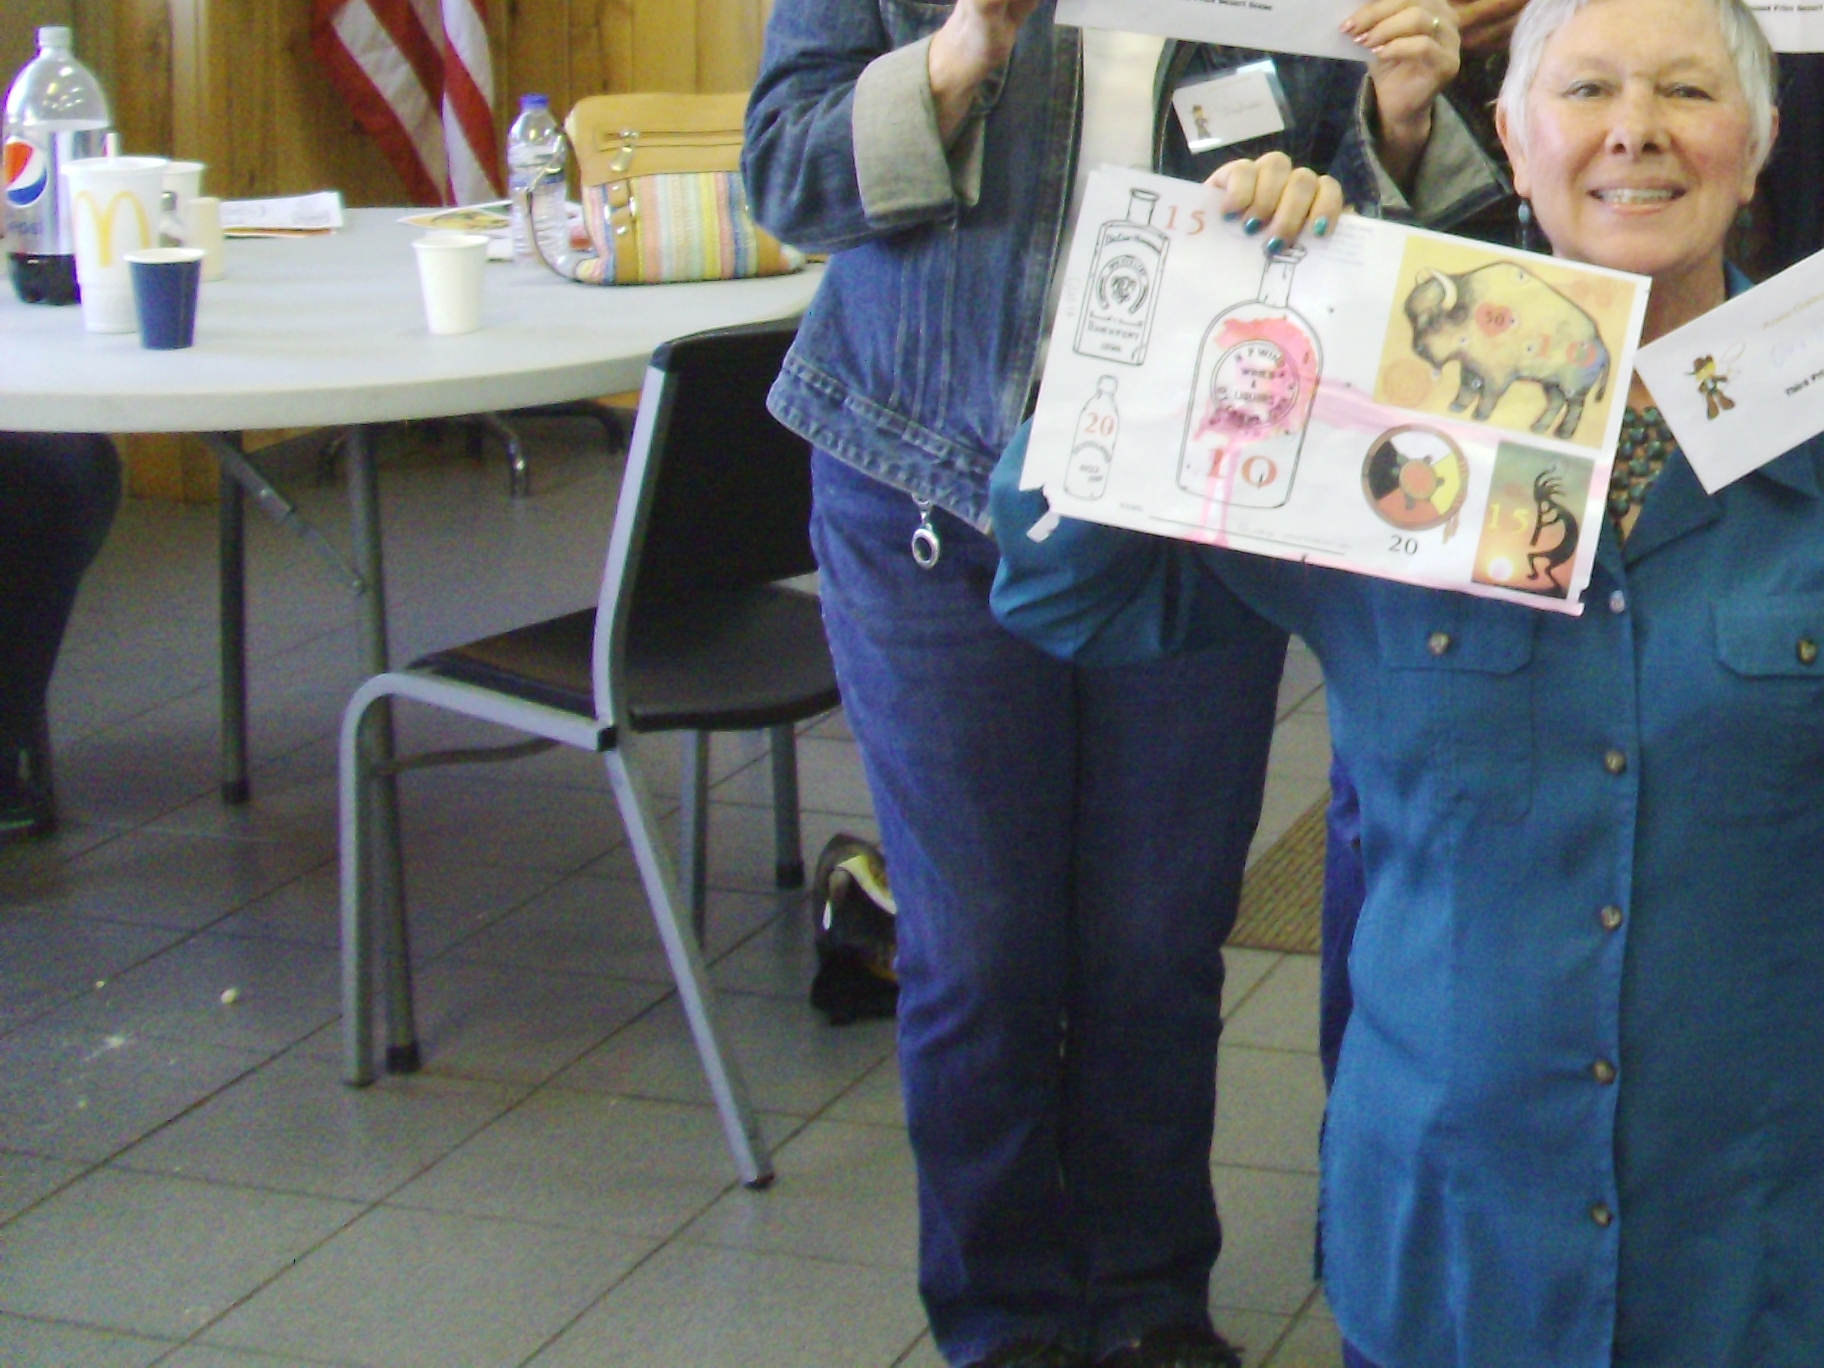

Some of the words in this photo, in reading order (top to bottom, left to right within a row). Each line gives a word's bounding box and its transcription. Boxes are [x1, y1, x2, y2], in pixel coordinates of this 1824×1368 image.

[1164, 205, 1207, 236] 15
[1084, 412, 1115, 437] 20
[1206, 447, 1278, 489] 10
[1488, 503, 1530, 533] 15
[1388, 534, 1419, 556] 20
